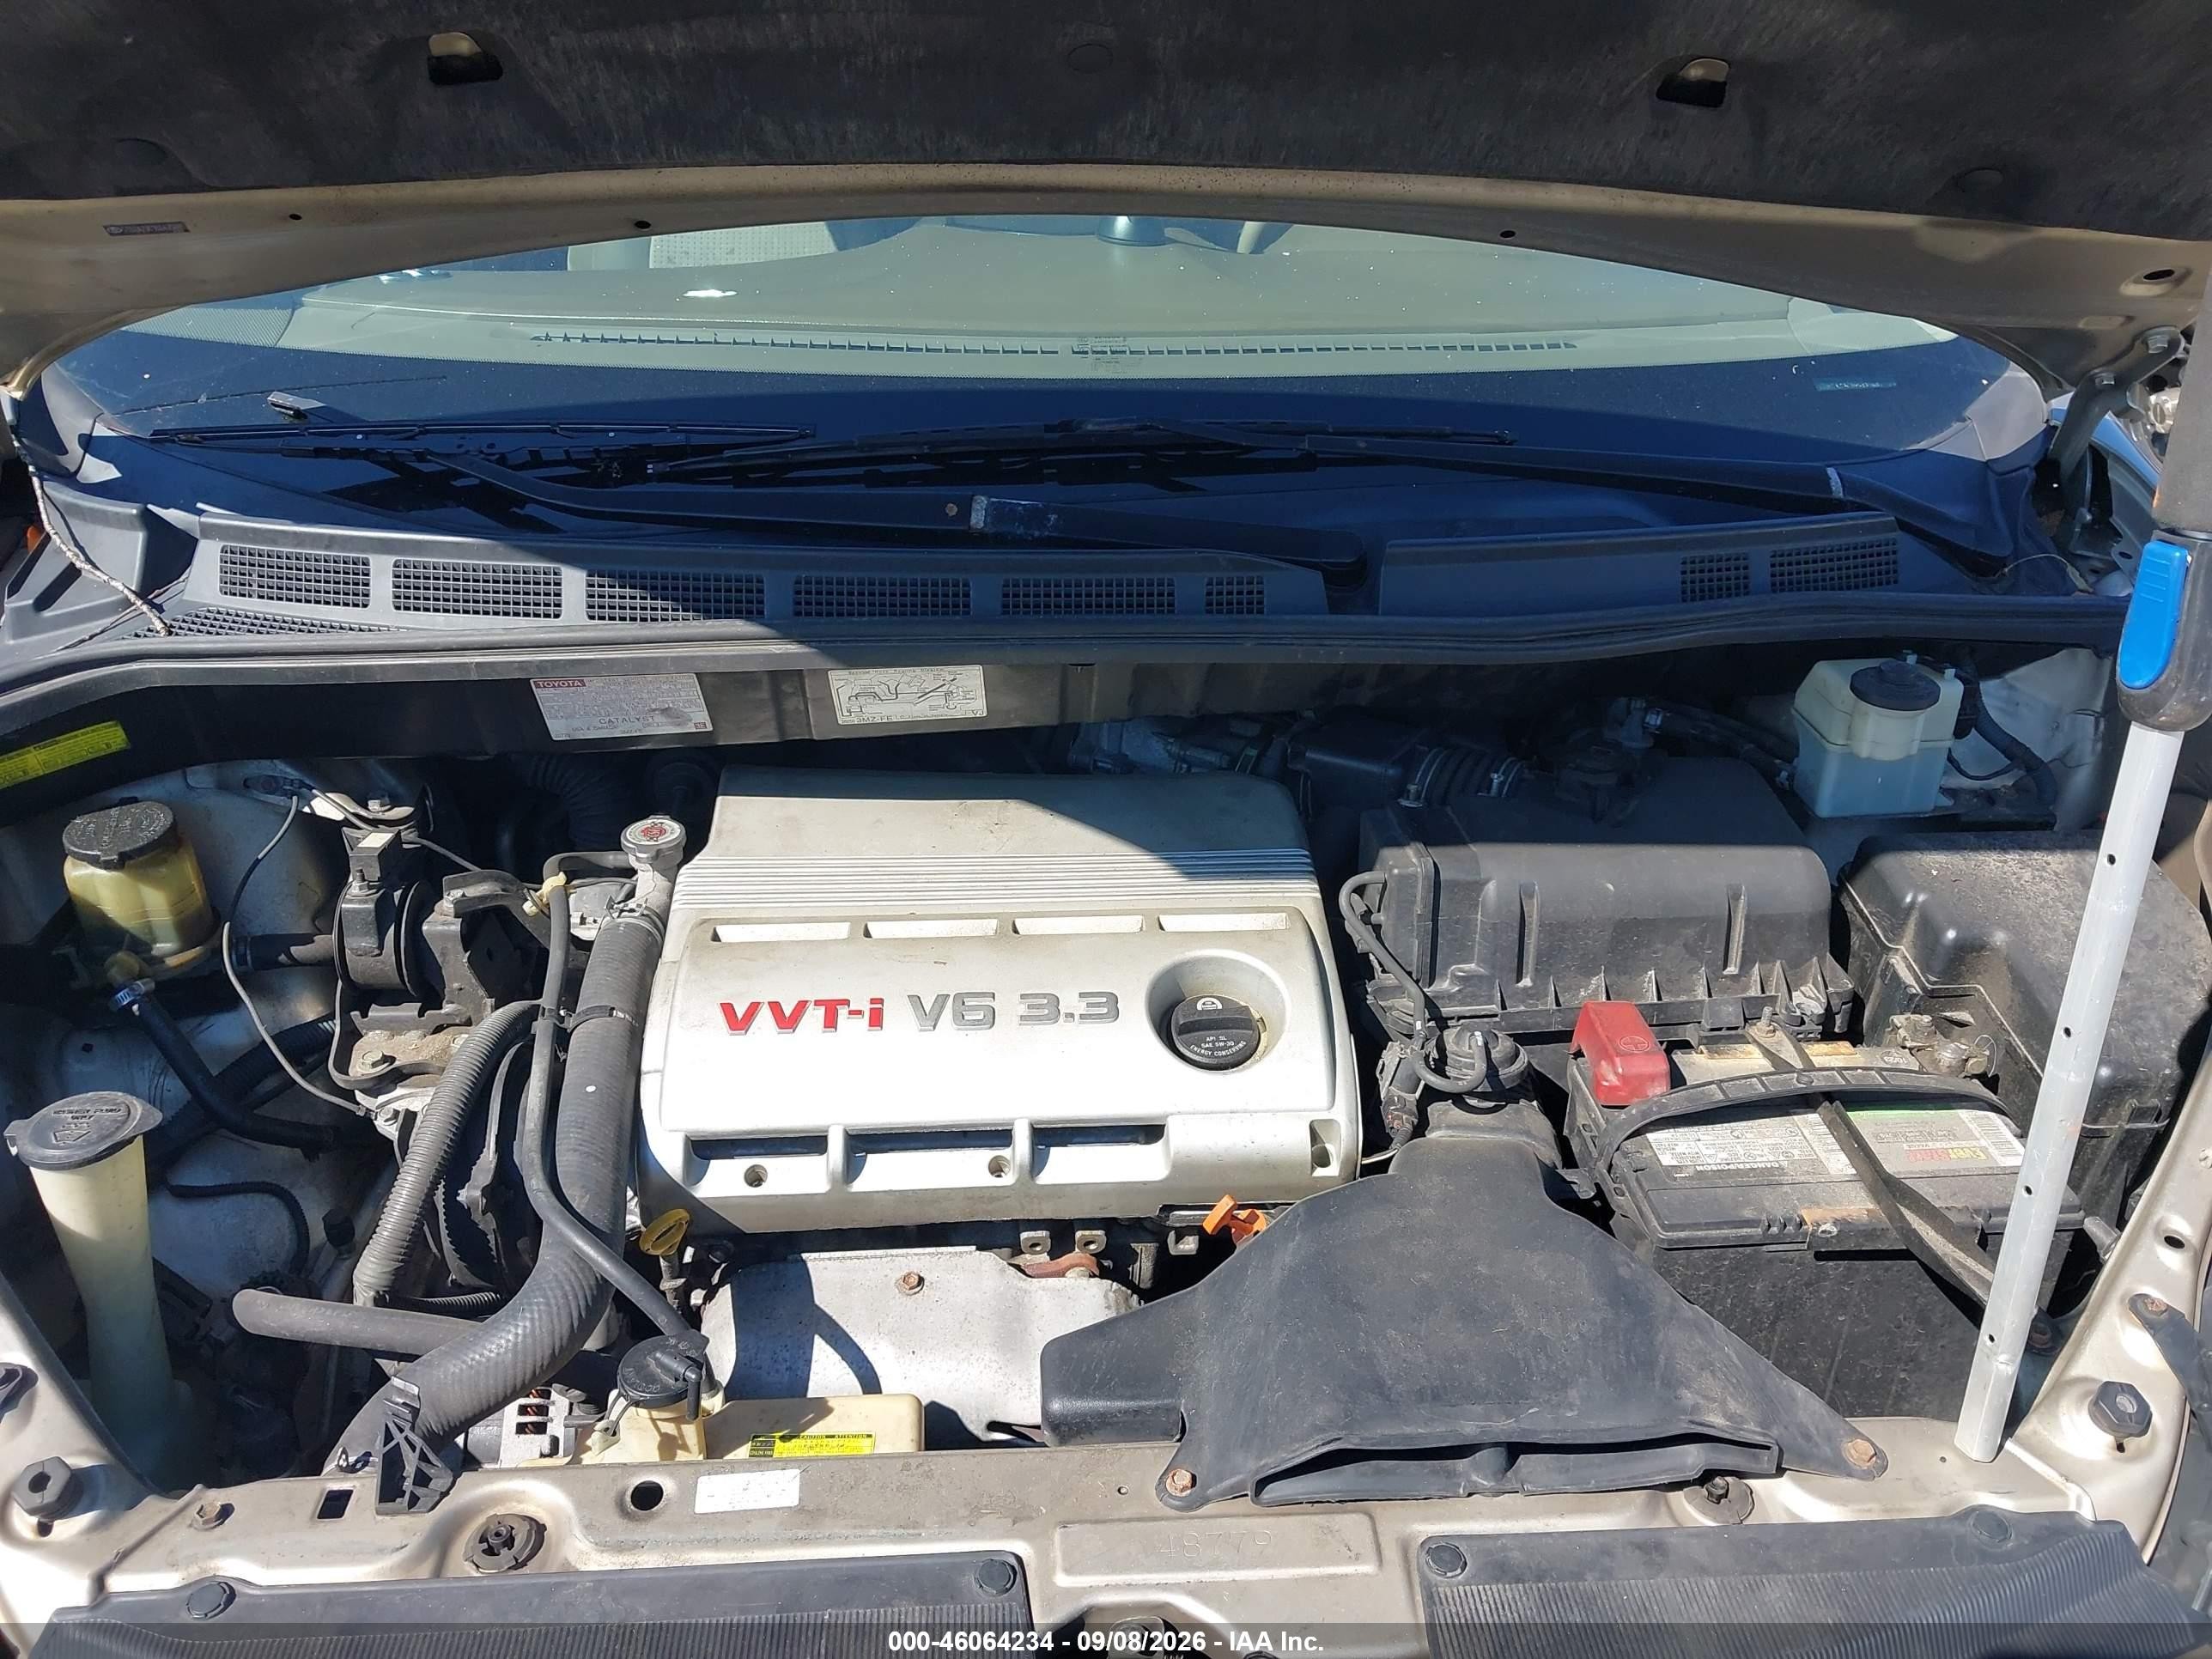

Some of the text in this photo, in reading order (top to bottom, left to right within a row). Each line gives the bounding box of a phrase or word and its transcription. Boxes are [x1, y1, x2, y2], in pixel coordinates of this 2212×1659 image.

[537, 680, 584, 689] TOYOTA
[599, 715, 655, 725] CATALYST
[717, 991, 1120, 1036] VVT-i V6 3.3
[1189, 1040, 1247, 1057] ENERGY CONSERVING
[1695, 1161, 1780, 1172] DANGER/POISON
